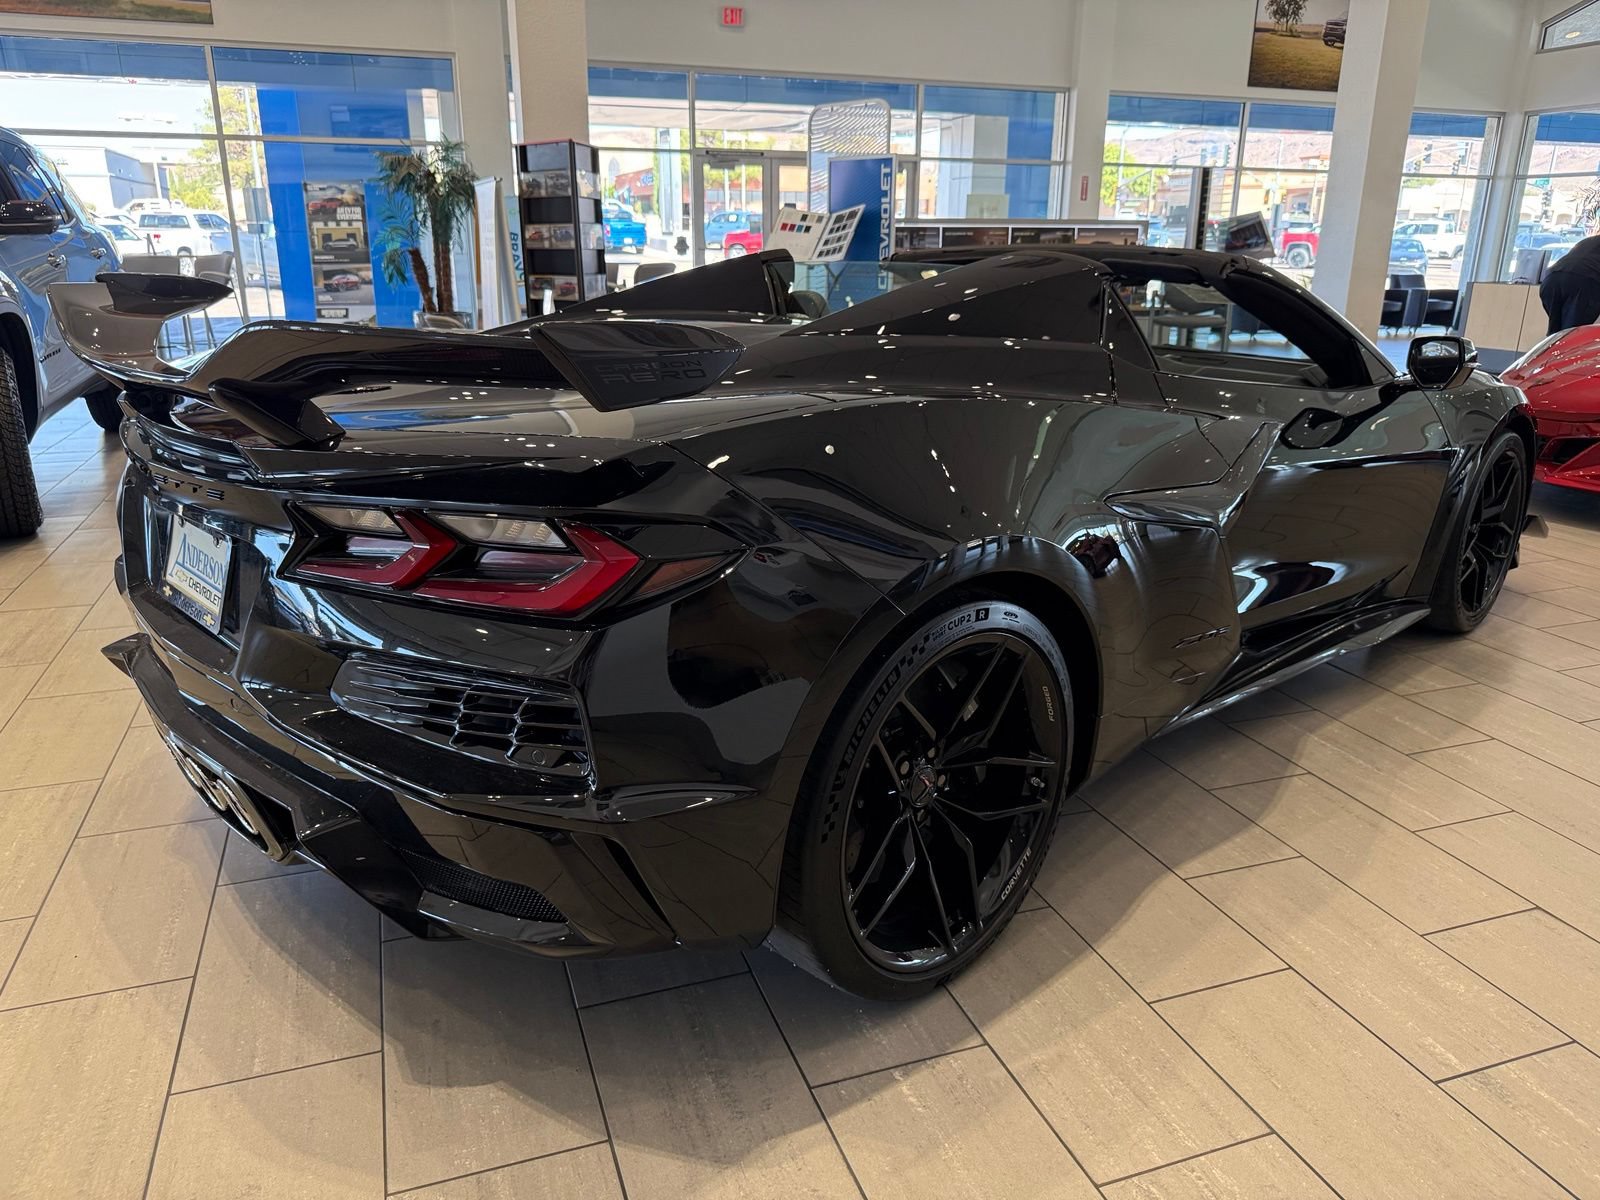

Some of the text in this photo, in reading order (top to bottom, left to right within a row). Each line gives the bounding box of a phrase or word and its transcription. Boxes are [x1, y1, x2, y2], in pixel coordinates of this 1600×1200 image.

[723, 8, 743, 25] EXIT
[595, 360, 703, 372] CARBON
[601, 369, 706, 384] AERO
[168, 533, 226, 588] ANDERSON
[188, 577, 221, 607] CHEVROLET
[843, 667, 900, 767] MICHELIN
[1042, 686, 1055, 722] FORGED
[1001, 847, 1032, 901] CORVETTE
